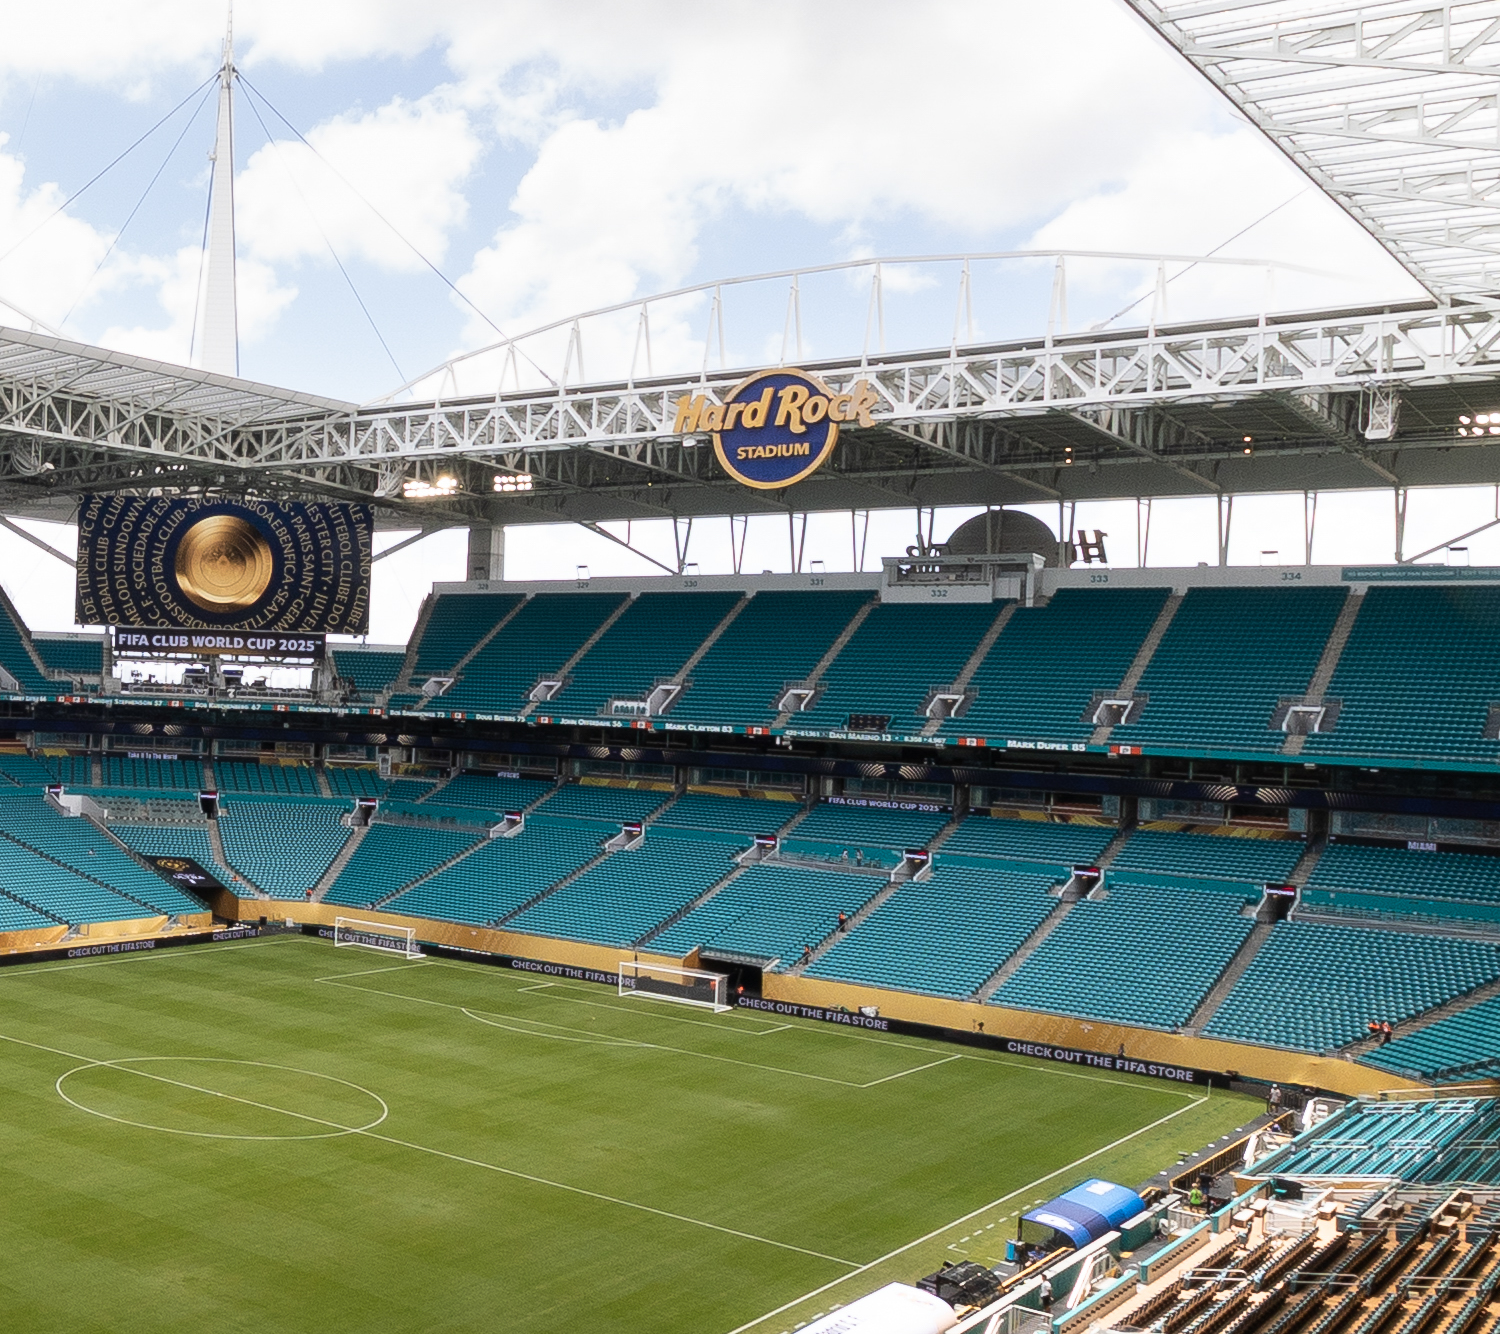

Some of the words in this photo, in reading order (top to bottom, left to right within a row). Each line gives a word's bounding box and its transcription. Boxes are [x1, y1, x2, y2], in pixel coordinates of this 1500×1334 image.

[673, 386, 775, 434] Hard
[773, 378, 878, 435] Rock
[736, 442, 810, 460] STADIUM
[1089, 574, 1110, 584] 333
[1281, 571, 1302, 581] 334
[930, 588, 948, 599] 332
[119, 632, 148, 647] FIFA
[152, 634, 188, 648] CLUB
[191, 635, 245, 650] WORLD
[248, 637, 277, 651] CUP
[737, 996, 775, 1012] CHECK
[775, 1002, 799, 1015] OUT
[799, 1006, 823, 1020] THE
[825, 1010, 851, 1024] FIFA
[850, 1015, 889, 1031] STORE
[1006, 1040, 1053, 1058] CHECK
[1053, 1048, 1083, 1063] OUT
[1084, 1053, 1113, 1068] THE
[1114, 1057, 1147, 1074] FIFA
[1146, 1063, 1194, 1082] STORE
